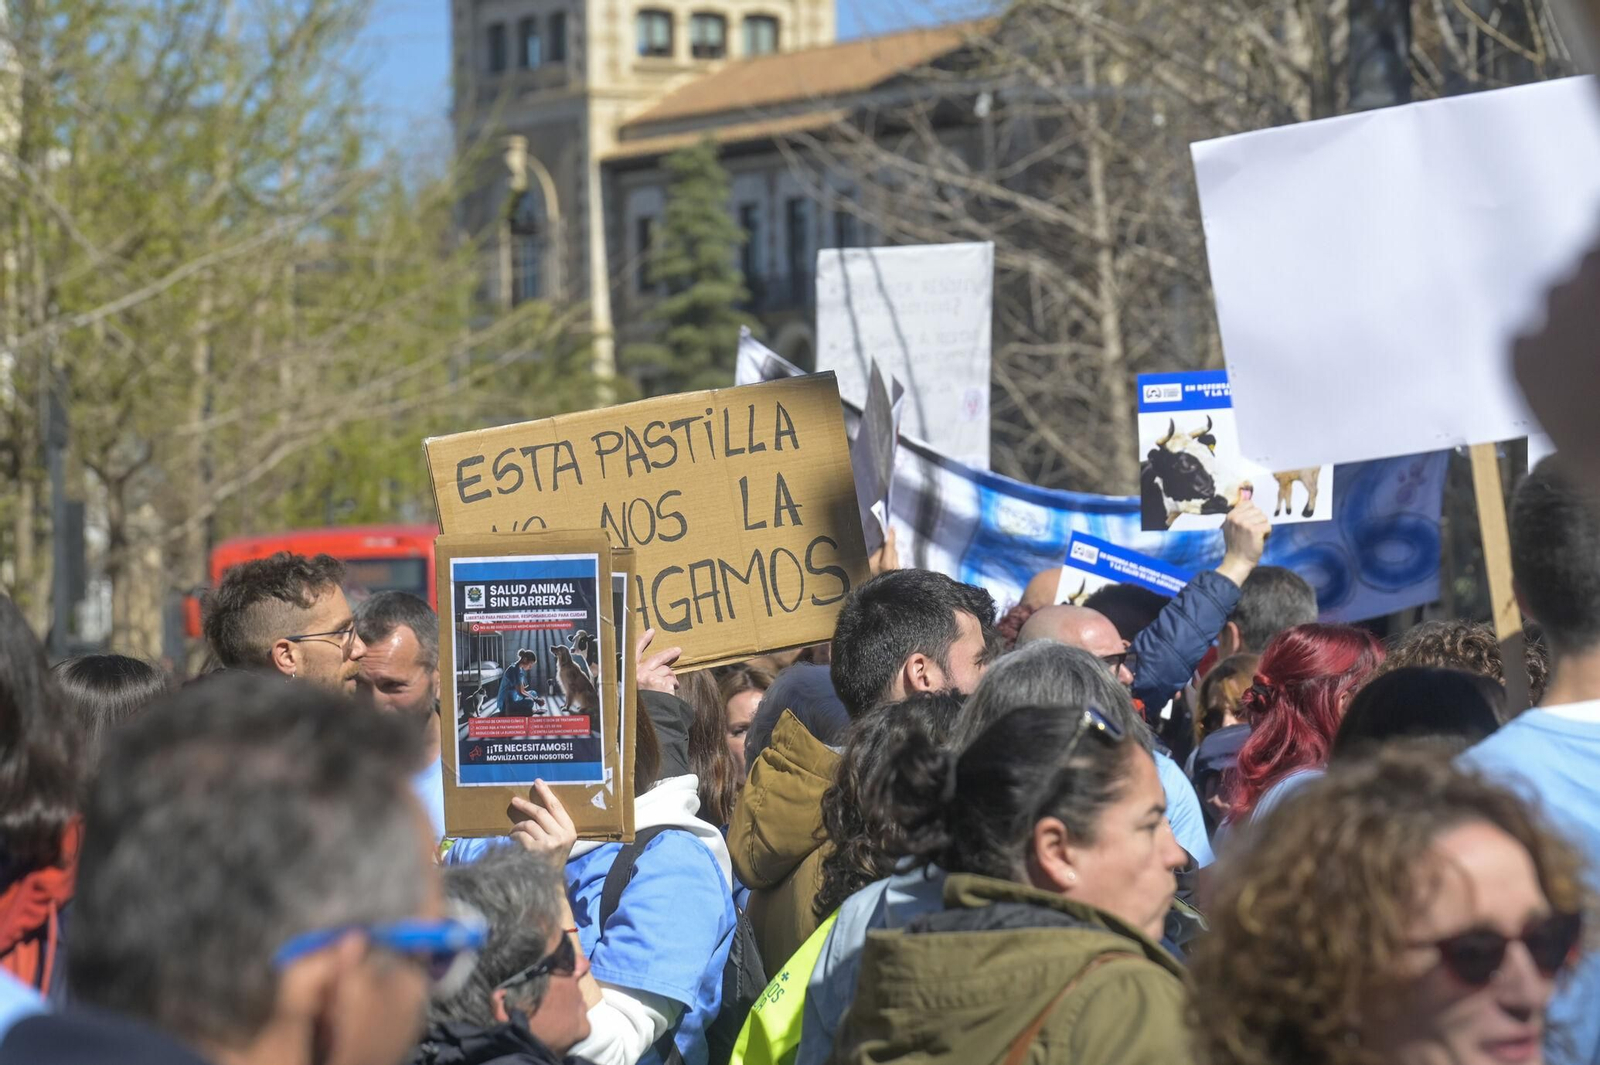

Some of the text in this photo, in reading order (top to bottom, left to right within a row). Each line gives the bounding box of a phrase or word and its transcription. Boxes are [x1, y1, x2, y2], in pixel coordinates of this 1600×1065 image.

[456, 439, 583, 504] ESTA
[600, 471, 803, 548] NOS LA
[490, 582, 575, 596] SALUD ANIMAL
[490, 596, 509, 608] SIN
[486, 742, 573, 754] ¡¡TE NECESITAMOS!!
[486, 753, 523, 761] MOVILÍZATE
